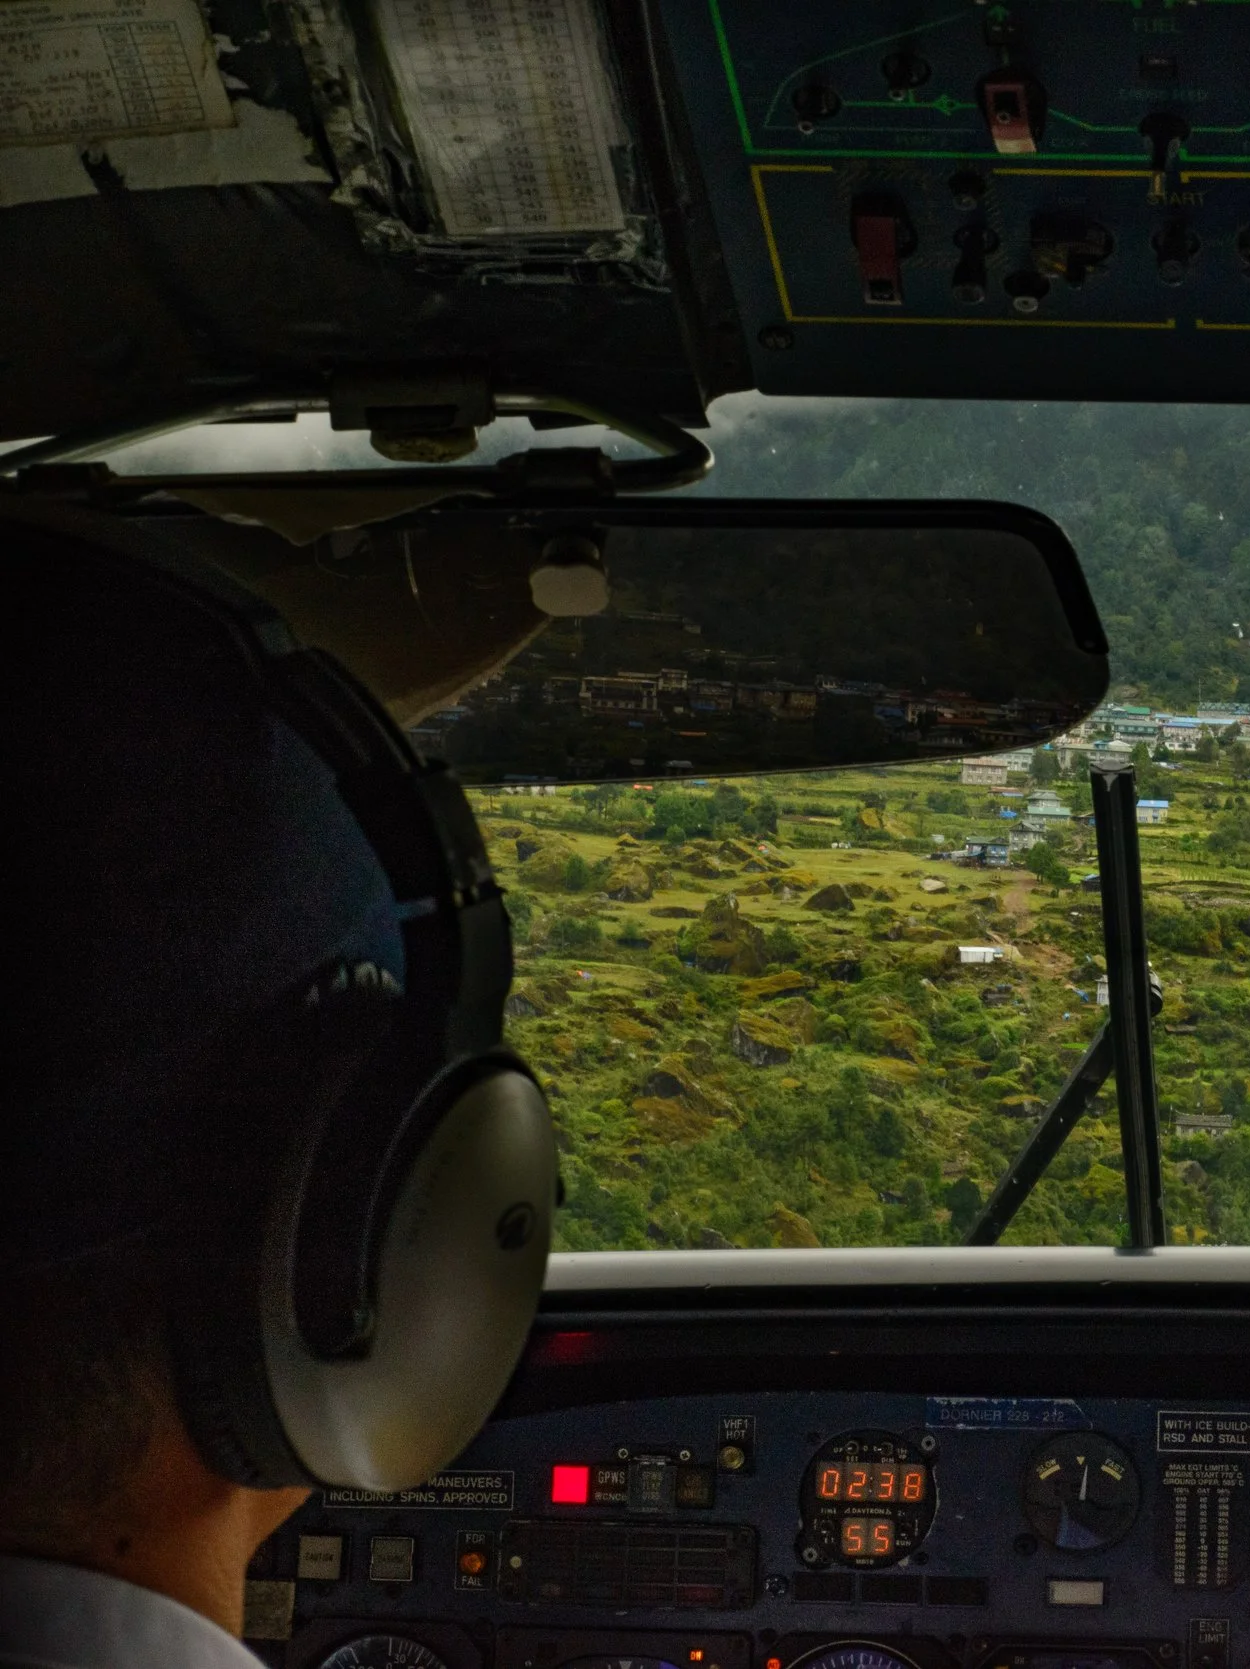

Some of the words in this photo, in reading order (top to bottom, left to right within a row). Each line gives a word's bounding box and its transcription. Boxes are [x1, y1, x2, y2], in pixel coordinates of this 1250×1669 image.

[939, 1409, 1002, 1421] DORNIER
[1164, 1420, 1192, 1431] WITH
[1195, 1420, 1213, 1431] ICE
[1163, 1433, 1186, 1443] RSD
[1191, 1433, 1214, 1443] AND
[1218, 1434, 1248, 1444] STALL
[597, 1471, 626, 1484] GPWS
[821, 1470, 923, 1499] 02:38
[442, 1492, 508, 1505] APPROVED
[845, 1524, 889, 1552] 55
[461, 1576, 482, 1587] FAIL
[1199, 1621, 1223, 1632] ENG
[1198, 1633, 1226, 1644] LIMIT
